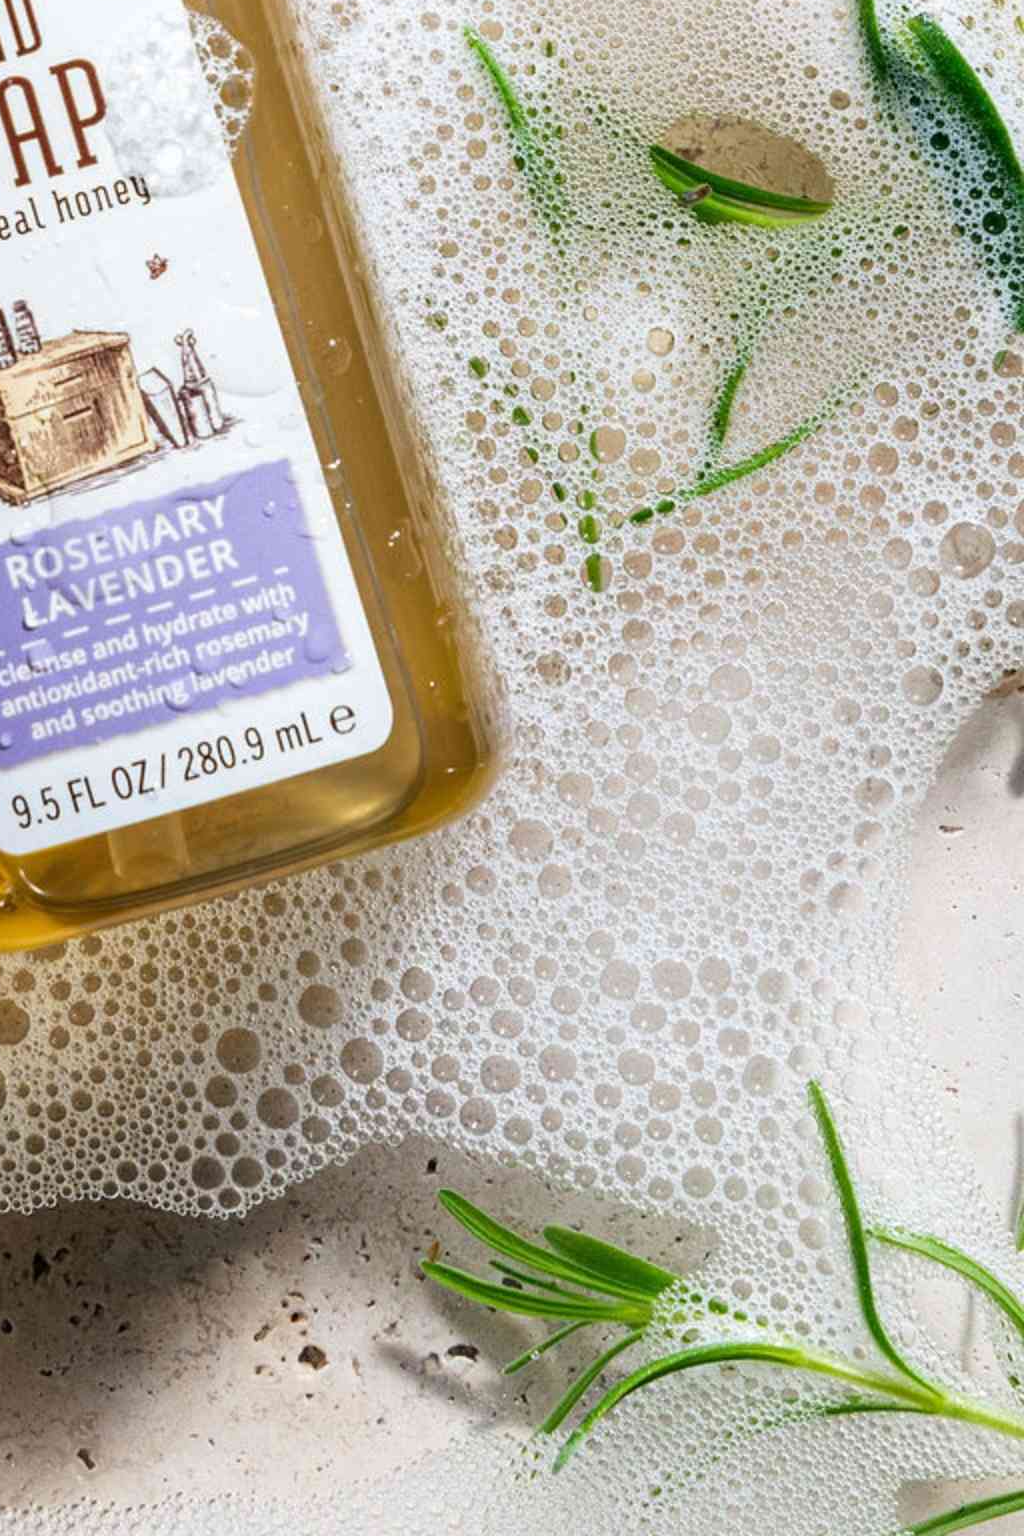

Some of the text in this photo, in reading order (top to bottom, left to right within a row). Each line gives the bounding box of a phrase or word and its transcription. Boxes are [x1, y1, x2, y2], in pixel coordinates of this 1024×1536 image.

[52, 175, 151, 223] honey
[4, 495, 229, 590] ROSEMARY
[21, 540, 240, 629] LAVENDER
[0, 610, 309, 719] antioxidant-rich rosemary
[92, 627, 139, 661] and
[142, 602, 238, 649] hydrate
[240, 583, 297, 615] with
[31, 646, 296, 741] and soothing lavender
[11, 785, 61, 829] 9.5
[68, 774, 106, 814] FL
[177, 726, 265, 782] 280.9
[275, 711, 323, 754] mL
